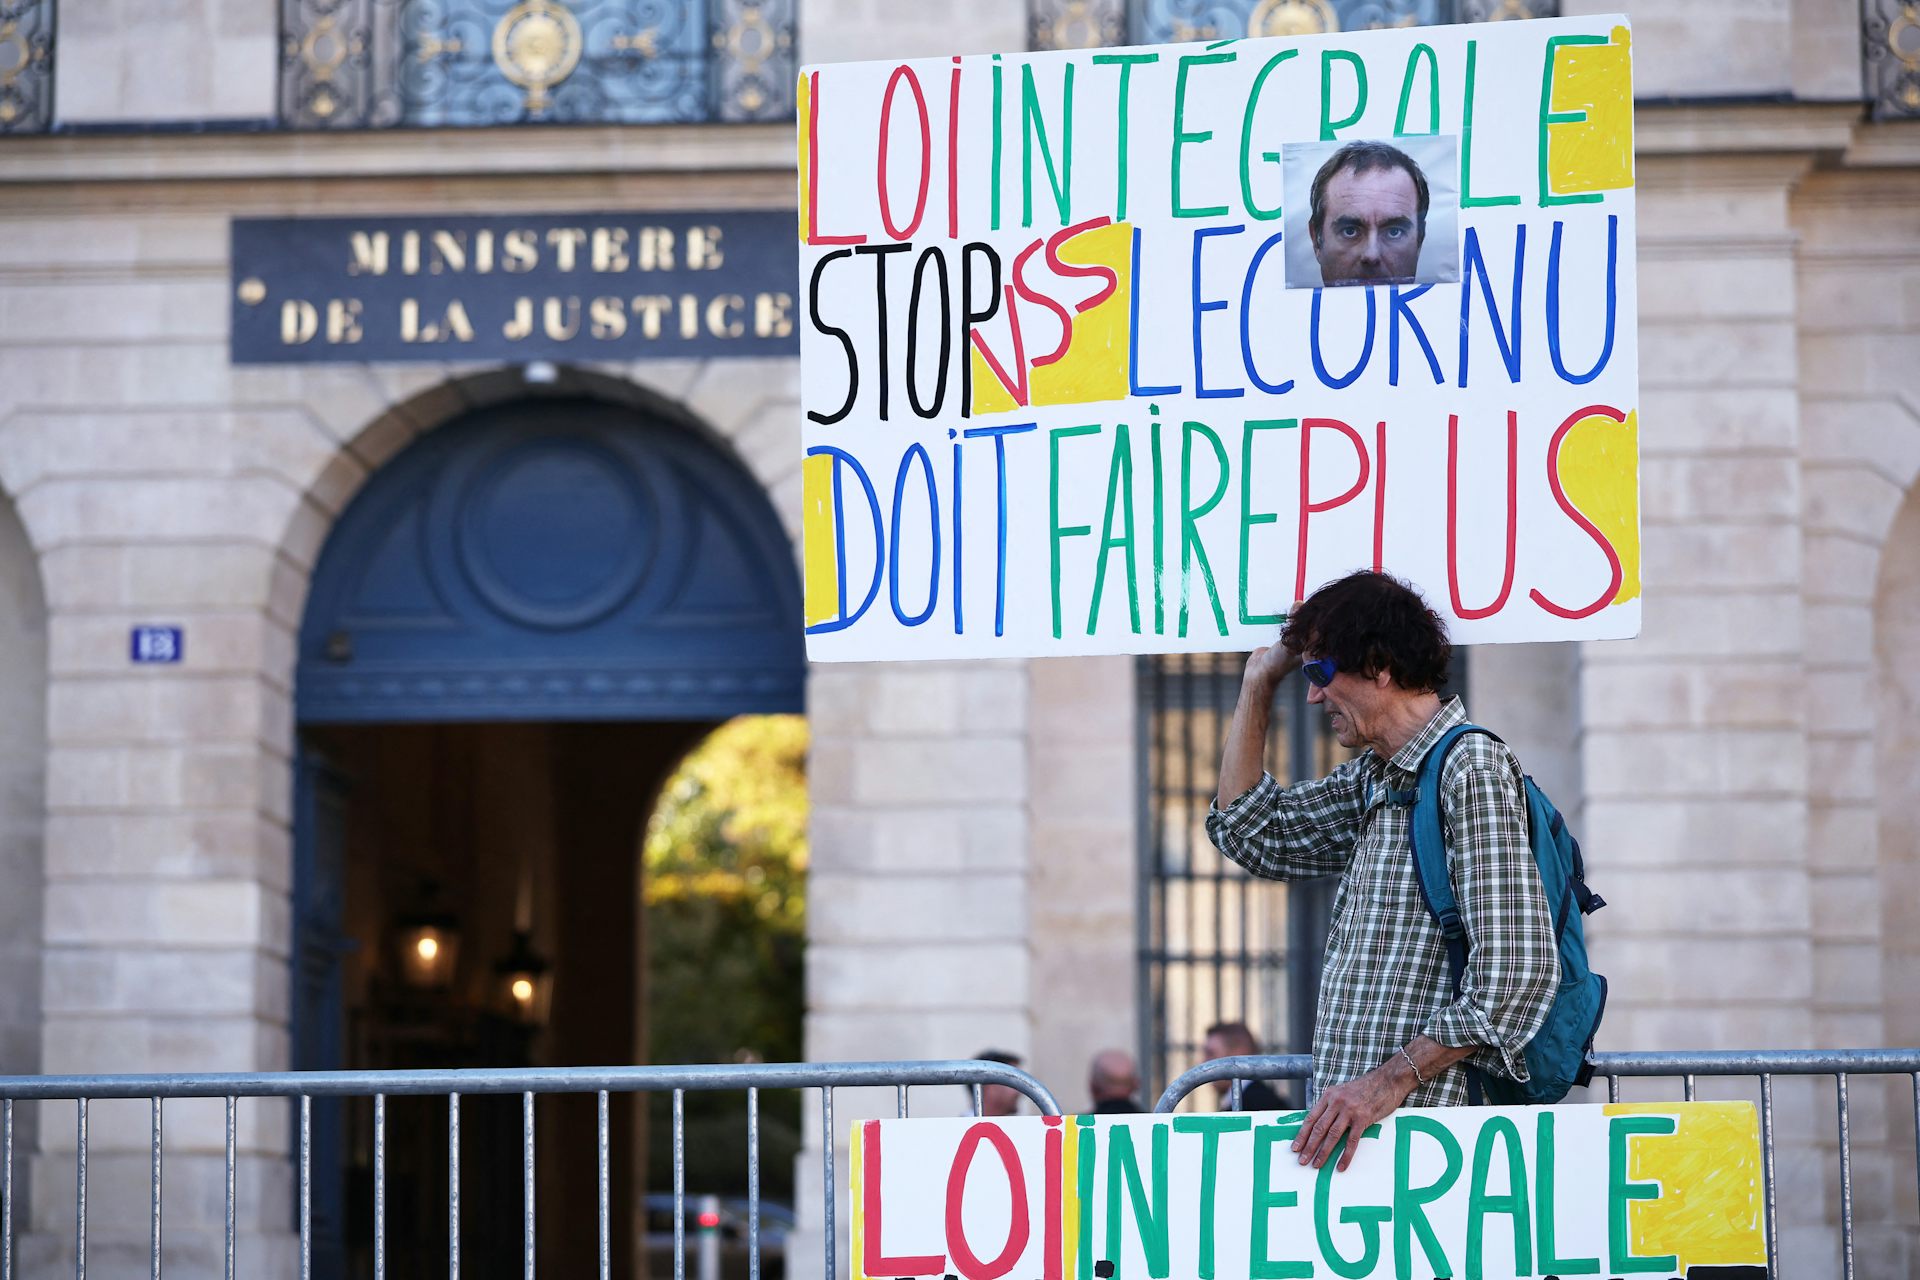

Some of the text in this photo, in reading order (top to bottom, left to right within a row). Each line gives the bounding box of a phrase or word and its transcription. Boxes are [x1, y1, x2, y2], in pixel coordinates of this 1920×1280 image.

[807, 56, 963, 246] LOI
[280, 292, 793, 344] DE LA JUSTICE
[347, 226, 724, 276] MINISTERE
[807, 241, 1001, 425] STOP
[1129, 214, 1618, 399] LECORNU
[805, 422, 1038, 637] DOIT
[1047, 403, 1298, 639] FAIRE
[863, 1109, 1678, 1280] LOI INTÉGRALE
